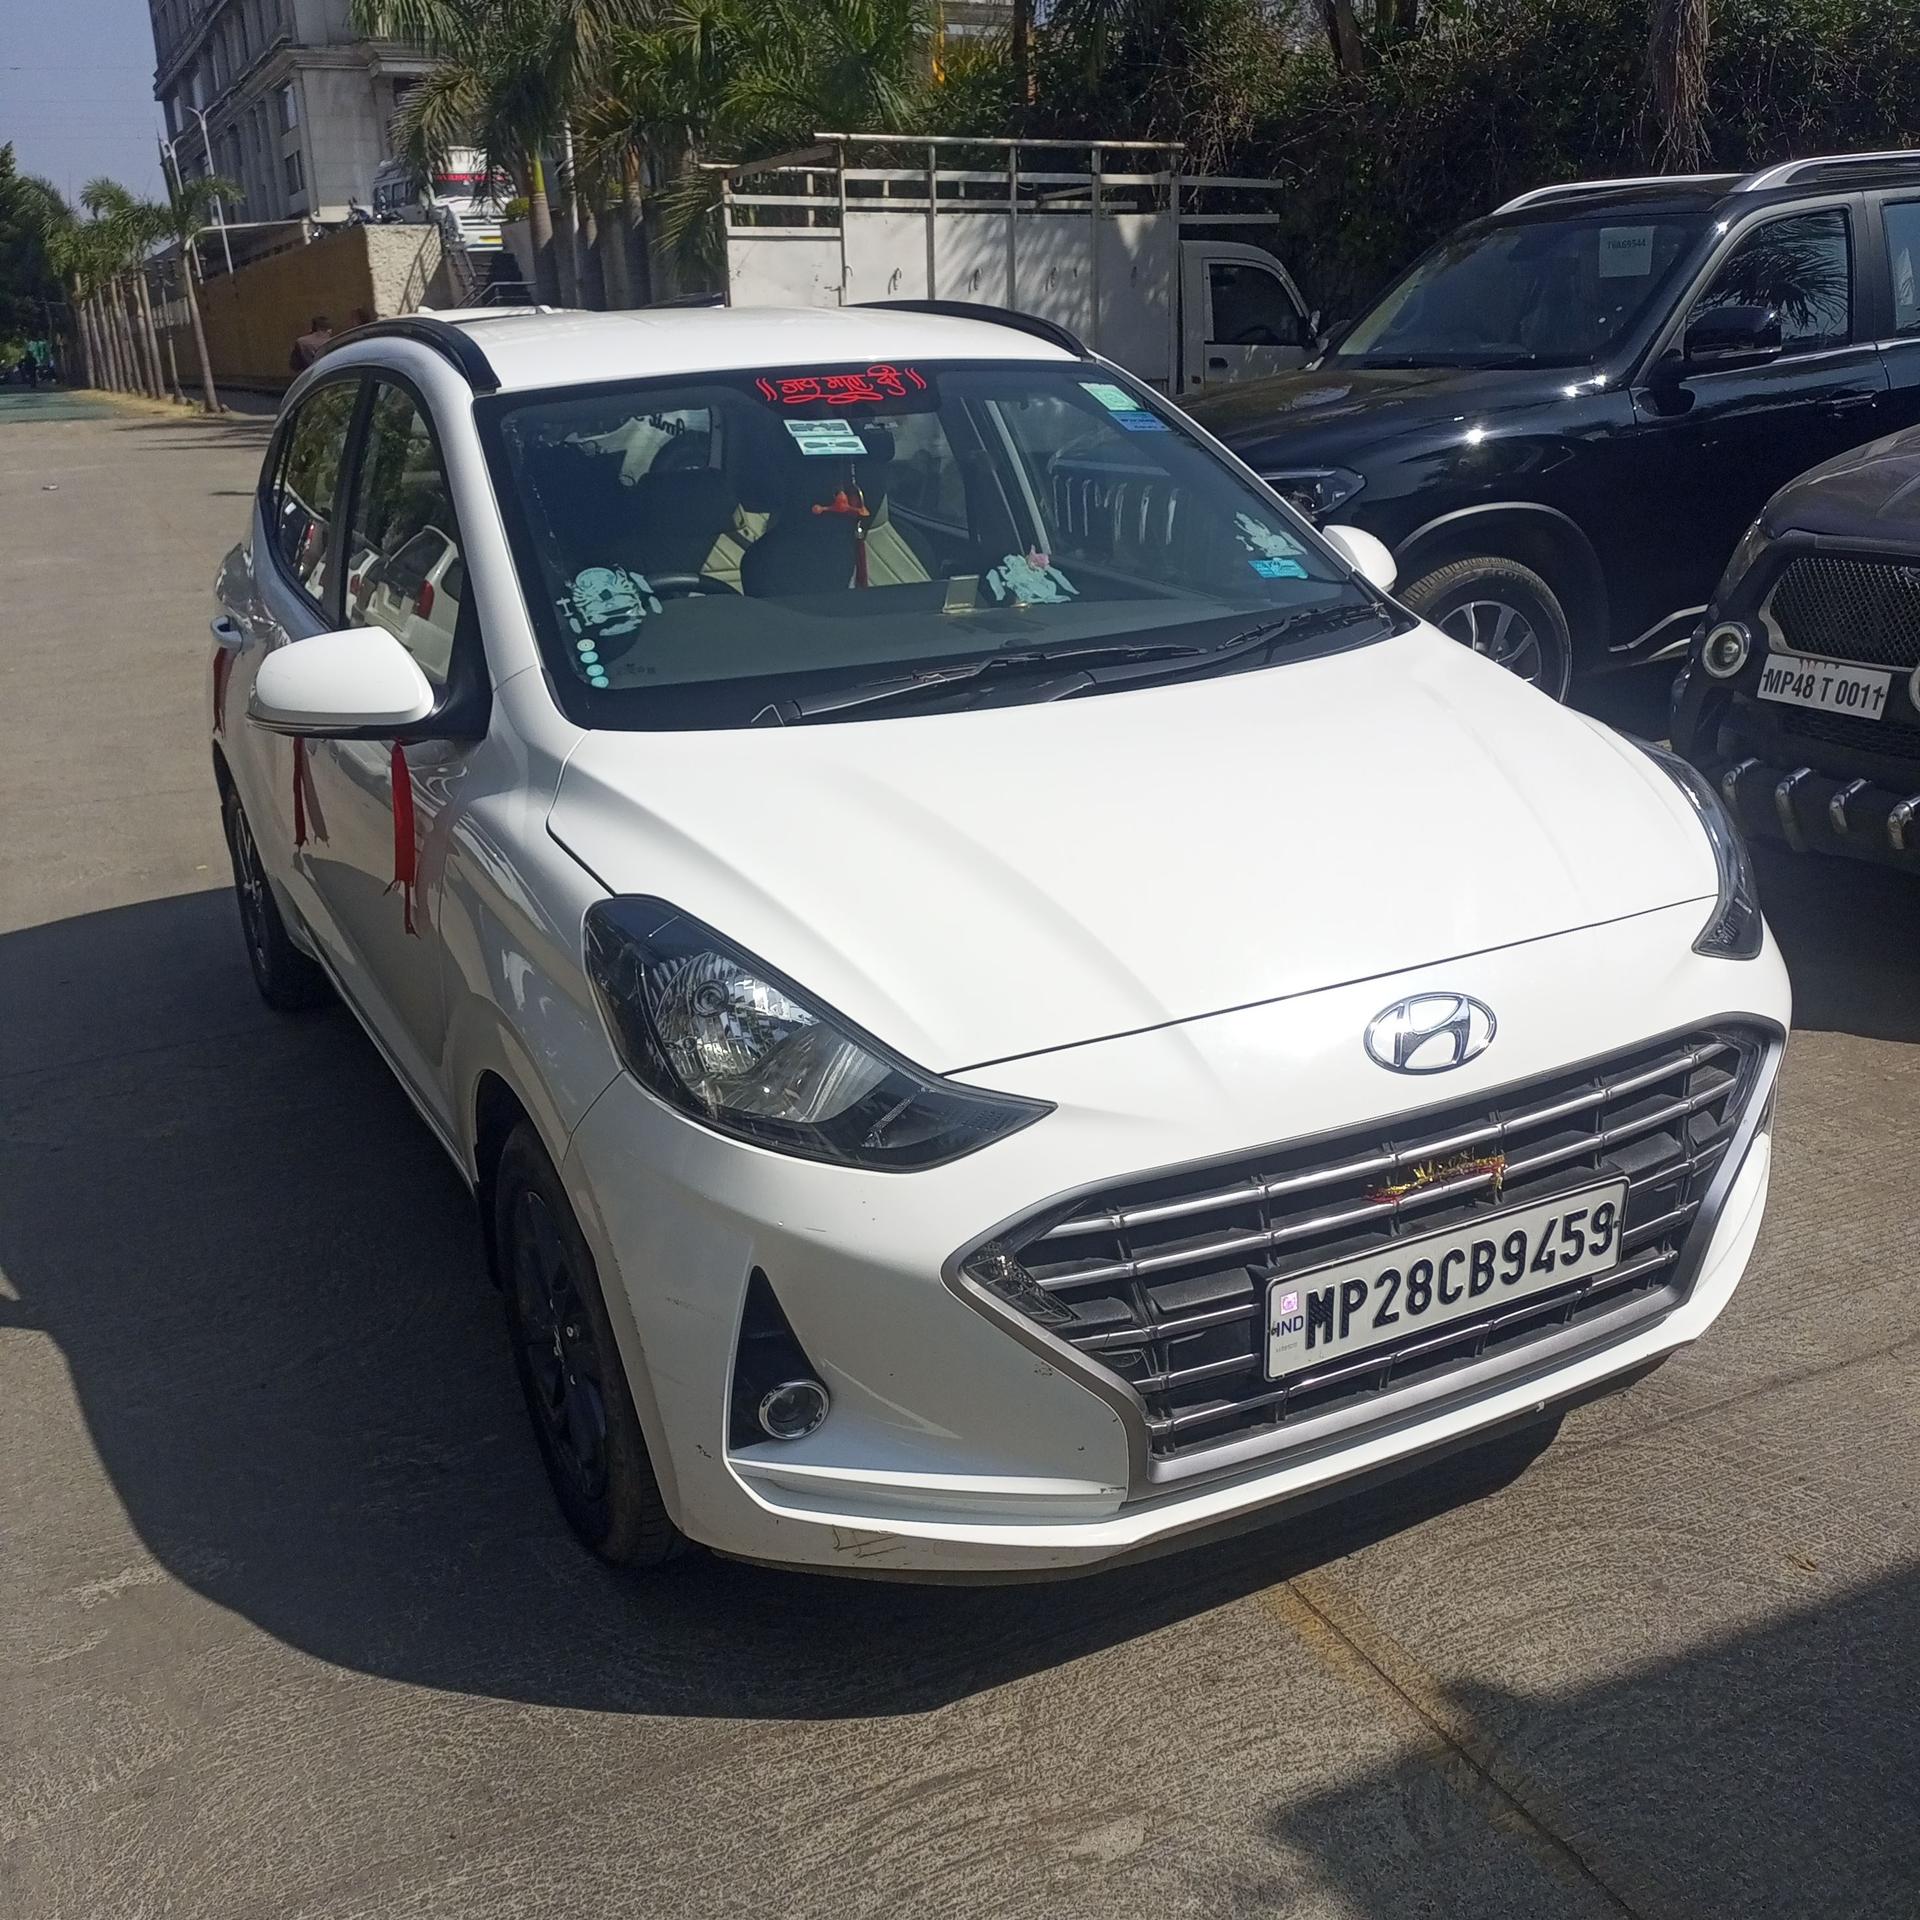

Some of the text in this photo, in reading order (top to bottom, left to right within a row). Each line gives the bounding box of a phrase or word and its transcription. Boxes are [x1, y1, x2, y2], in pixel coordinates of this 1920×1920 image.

[776, 376, 822, 402] जय
[1763, 668, 1883, 711] MP48 T 0011
[1304, 1202, 1617, 1350] MP28CB9459
[1276, 1315, 1304, 1338] IND
